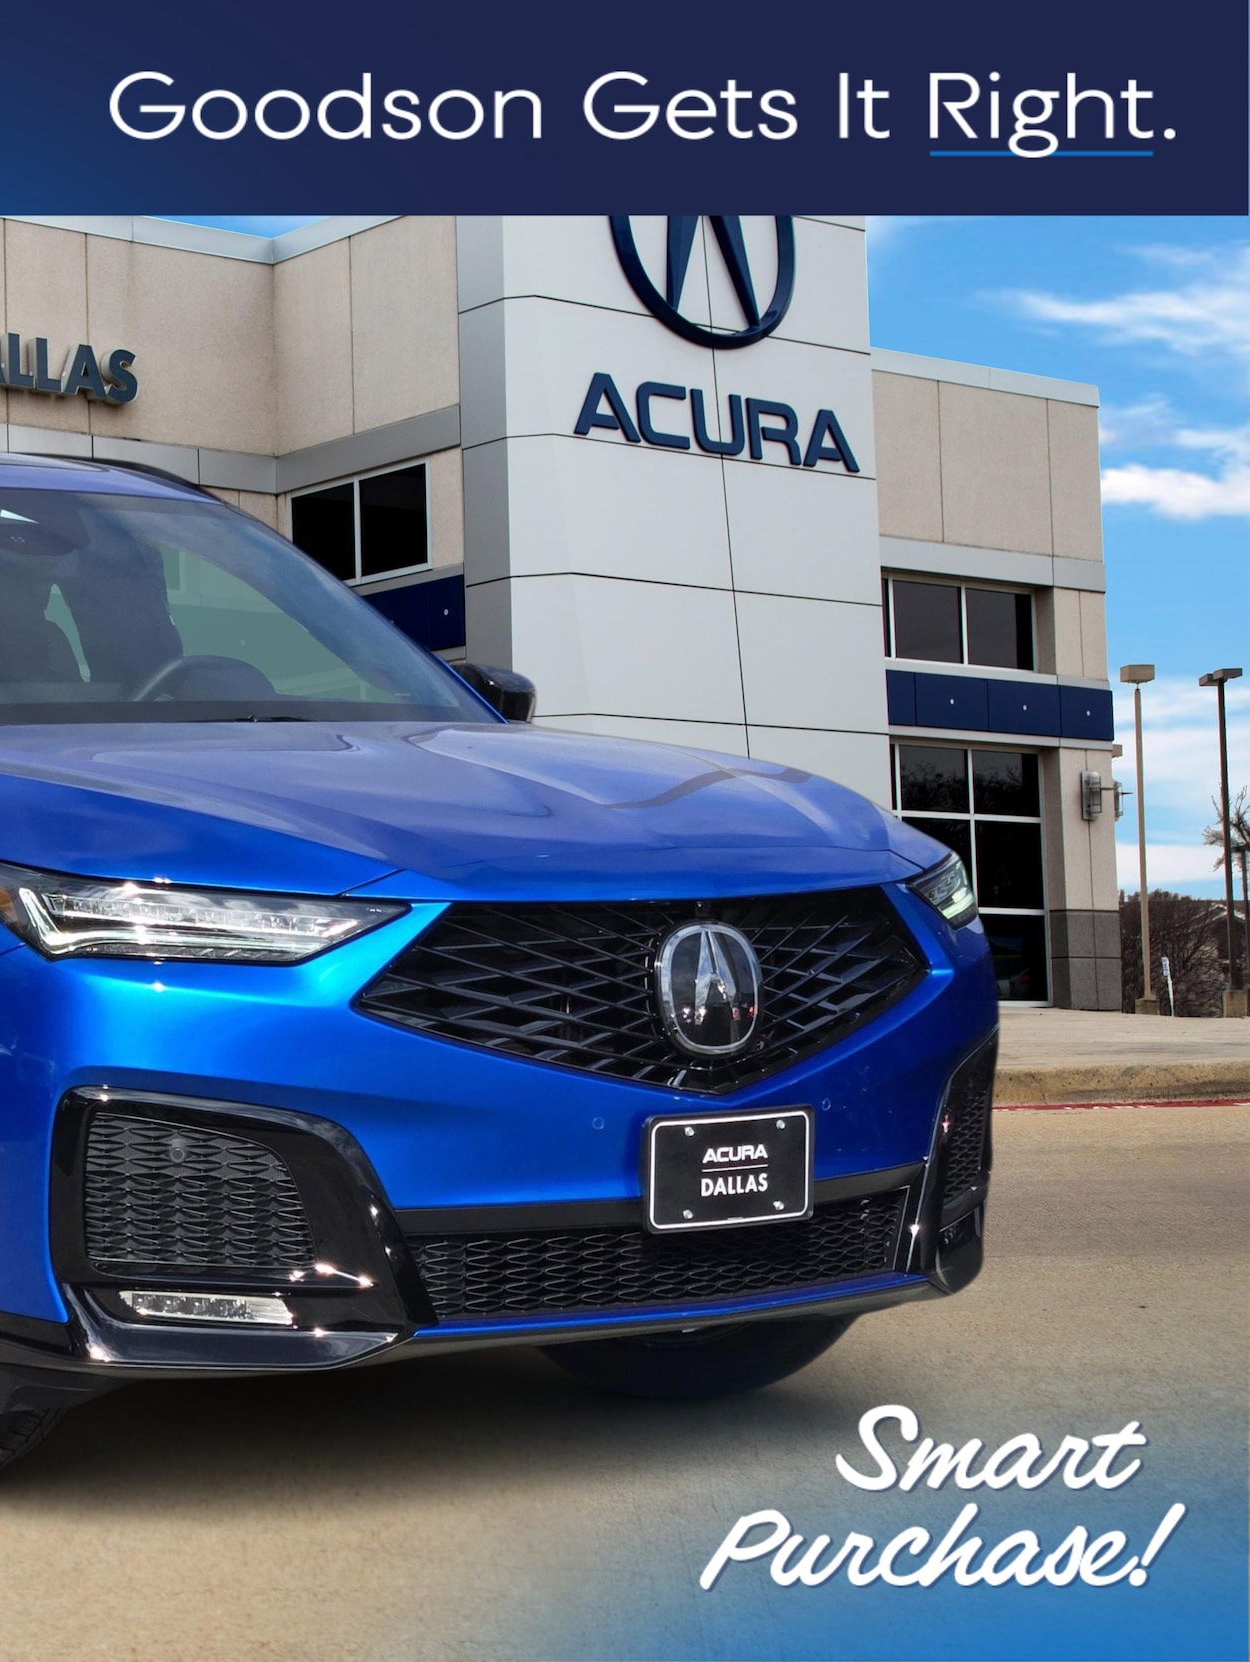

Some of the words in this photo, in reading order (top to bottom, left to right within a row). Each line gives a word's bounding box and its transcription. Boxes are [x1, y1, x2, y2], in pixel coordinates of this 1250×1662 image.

[573, 371, 860, 474] ACURA
[702, 1144, 768, 1164] ACURA
[701, 1173, 768, 1197] DALLAS
